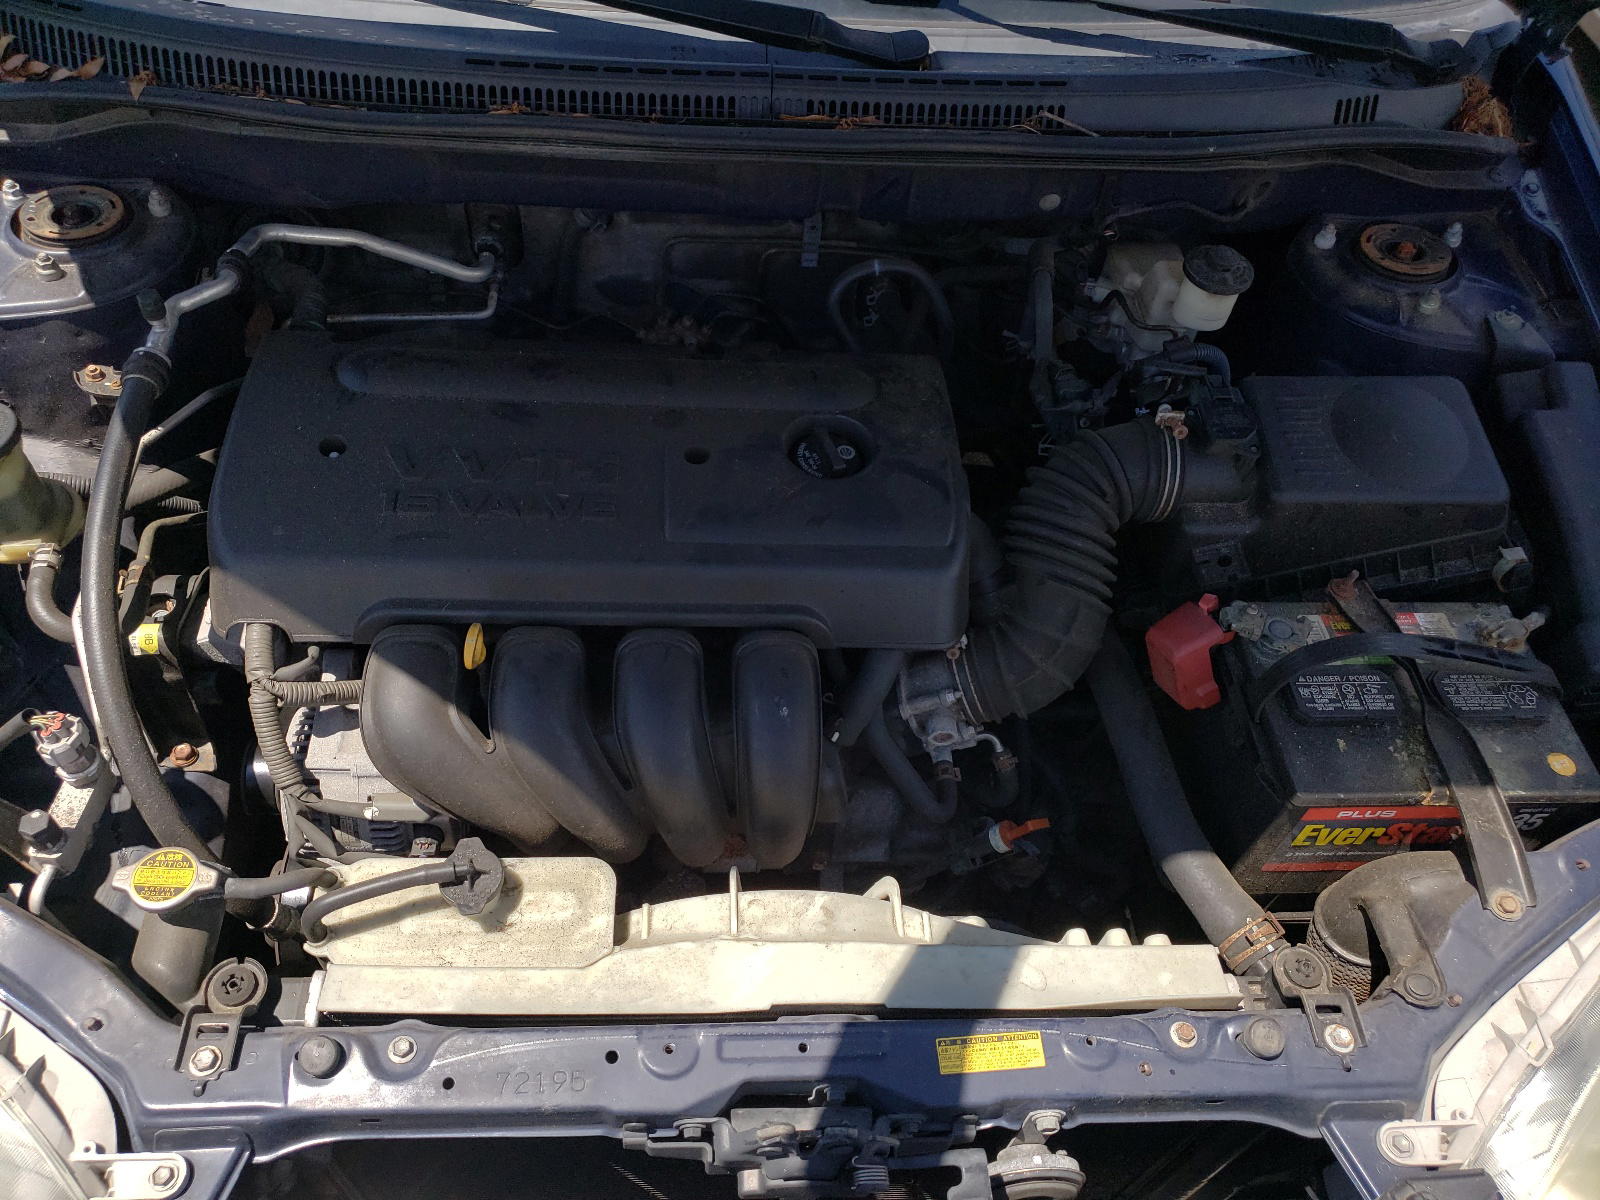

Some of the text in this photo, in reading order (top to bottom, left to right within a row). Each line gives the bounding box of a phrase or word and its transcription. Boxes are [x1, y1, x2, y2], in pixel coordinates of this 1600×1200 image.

[1337, 810, 1397, 819] PLUS
[1513, 813, 1550, 831] 35
[146, 860, 190, 868] CAUTION
[966, 1035, 998, 1044] CAUTION
[1003, 1032, 1038, 1041] ATTENTION
[496, 1070, 586, 1095] 72195
